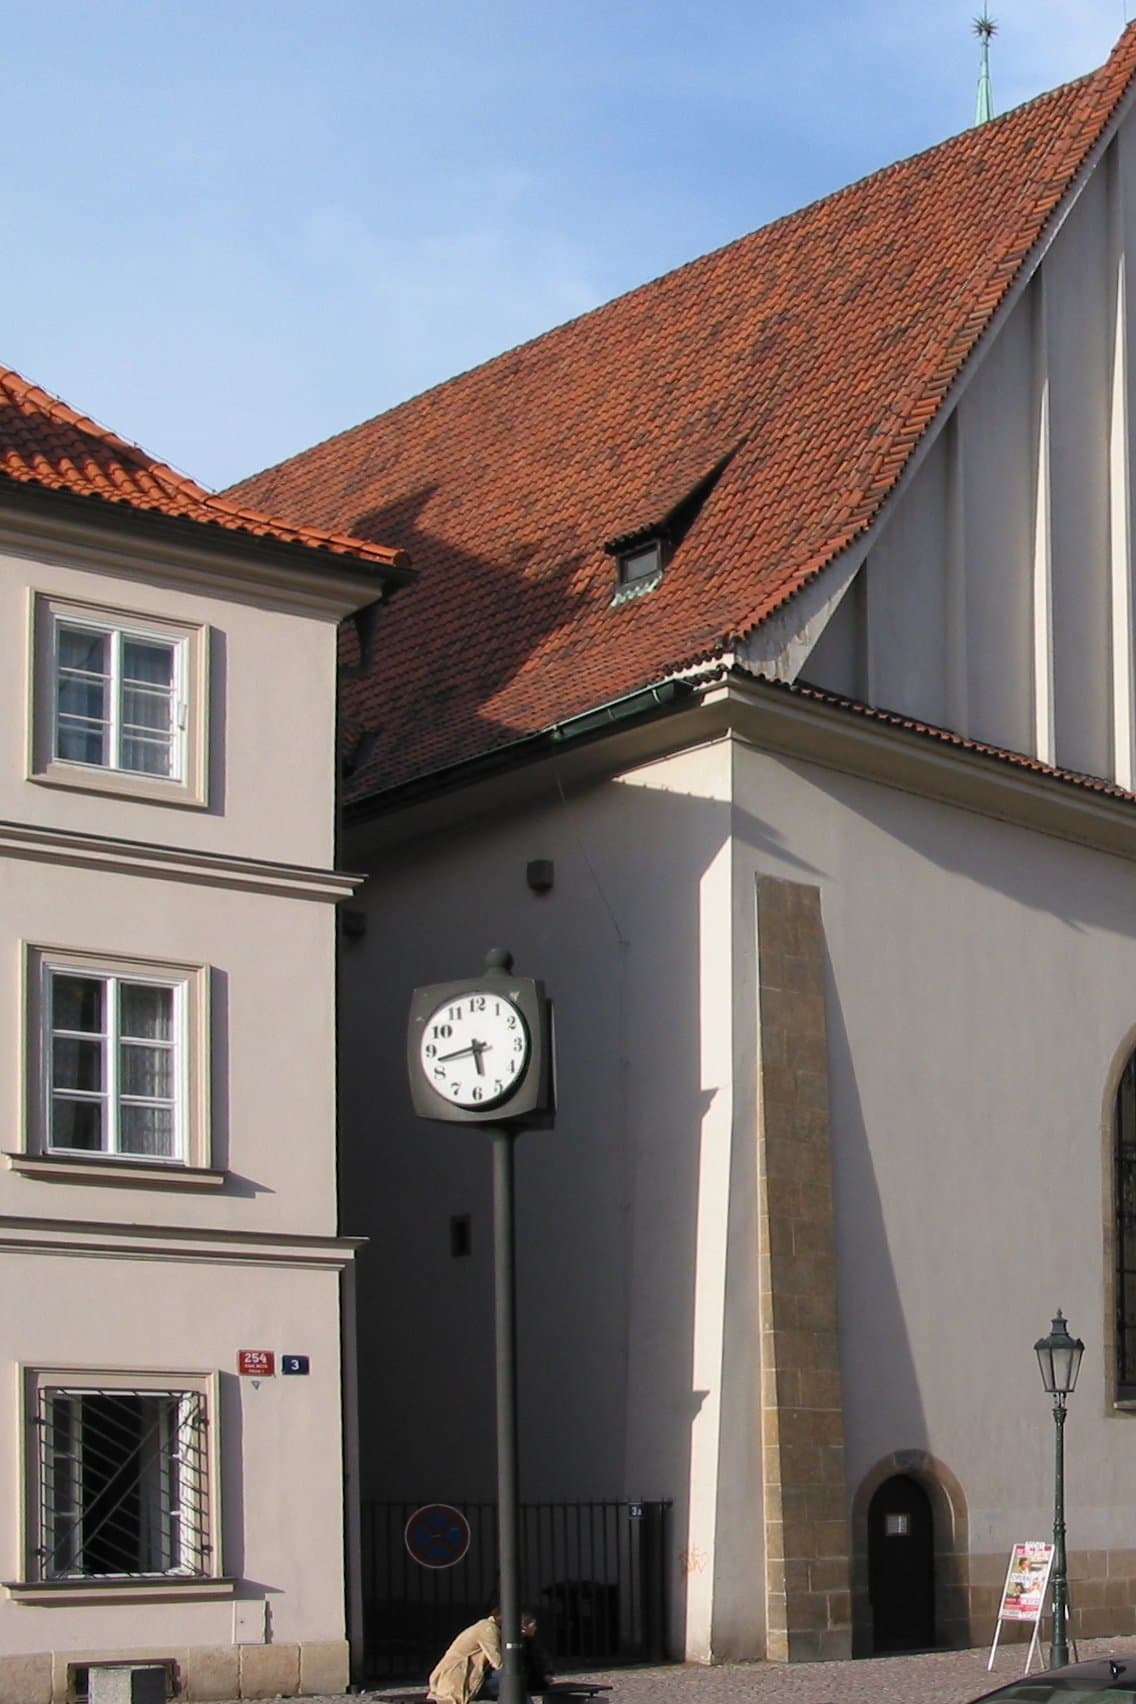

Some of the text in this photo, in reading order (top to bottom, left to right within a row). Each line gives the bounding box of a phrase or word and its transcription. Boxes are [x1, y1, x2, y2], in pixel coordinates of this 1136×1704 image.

[470, 997, 486, 1013] 12
[495, 1003, 501, 1016] 1
[449, 1006, 463, 1020] 11
[507, 1015, 517, 1029] 2
[432, 1024, 453, 1039] 10
[426, 1044, 438, 1058] 9
[514, 1037, 523, 1052] 3
[434, 1066, 447, 1080] 8
[508, 1059, 516, 1073] 4
[450, 1082, 462, 1096] 7
[494, 1079, 504, 1092] 5
[473, 1087, 483, 1101] 6
[244, 1352, 267, 1363] 254
[290, 1359, 300, 1370] 3
